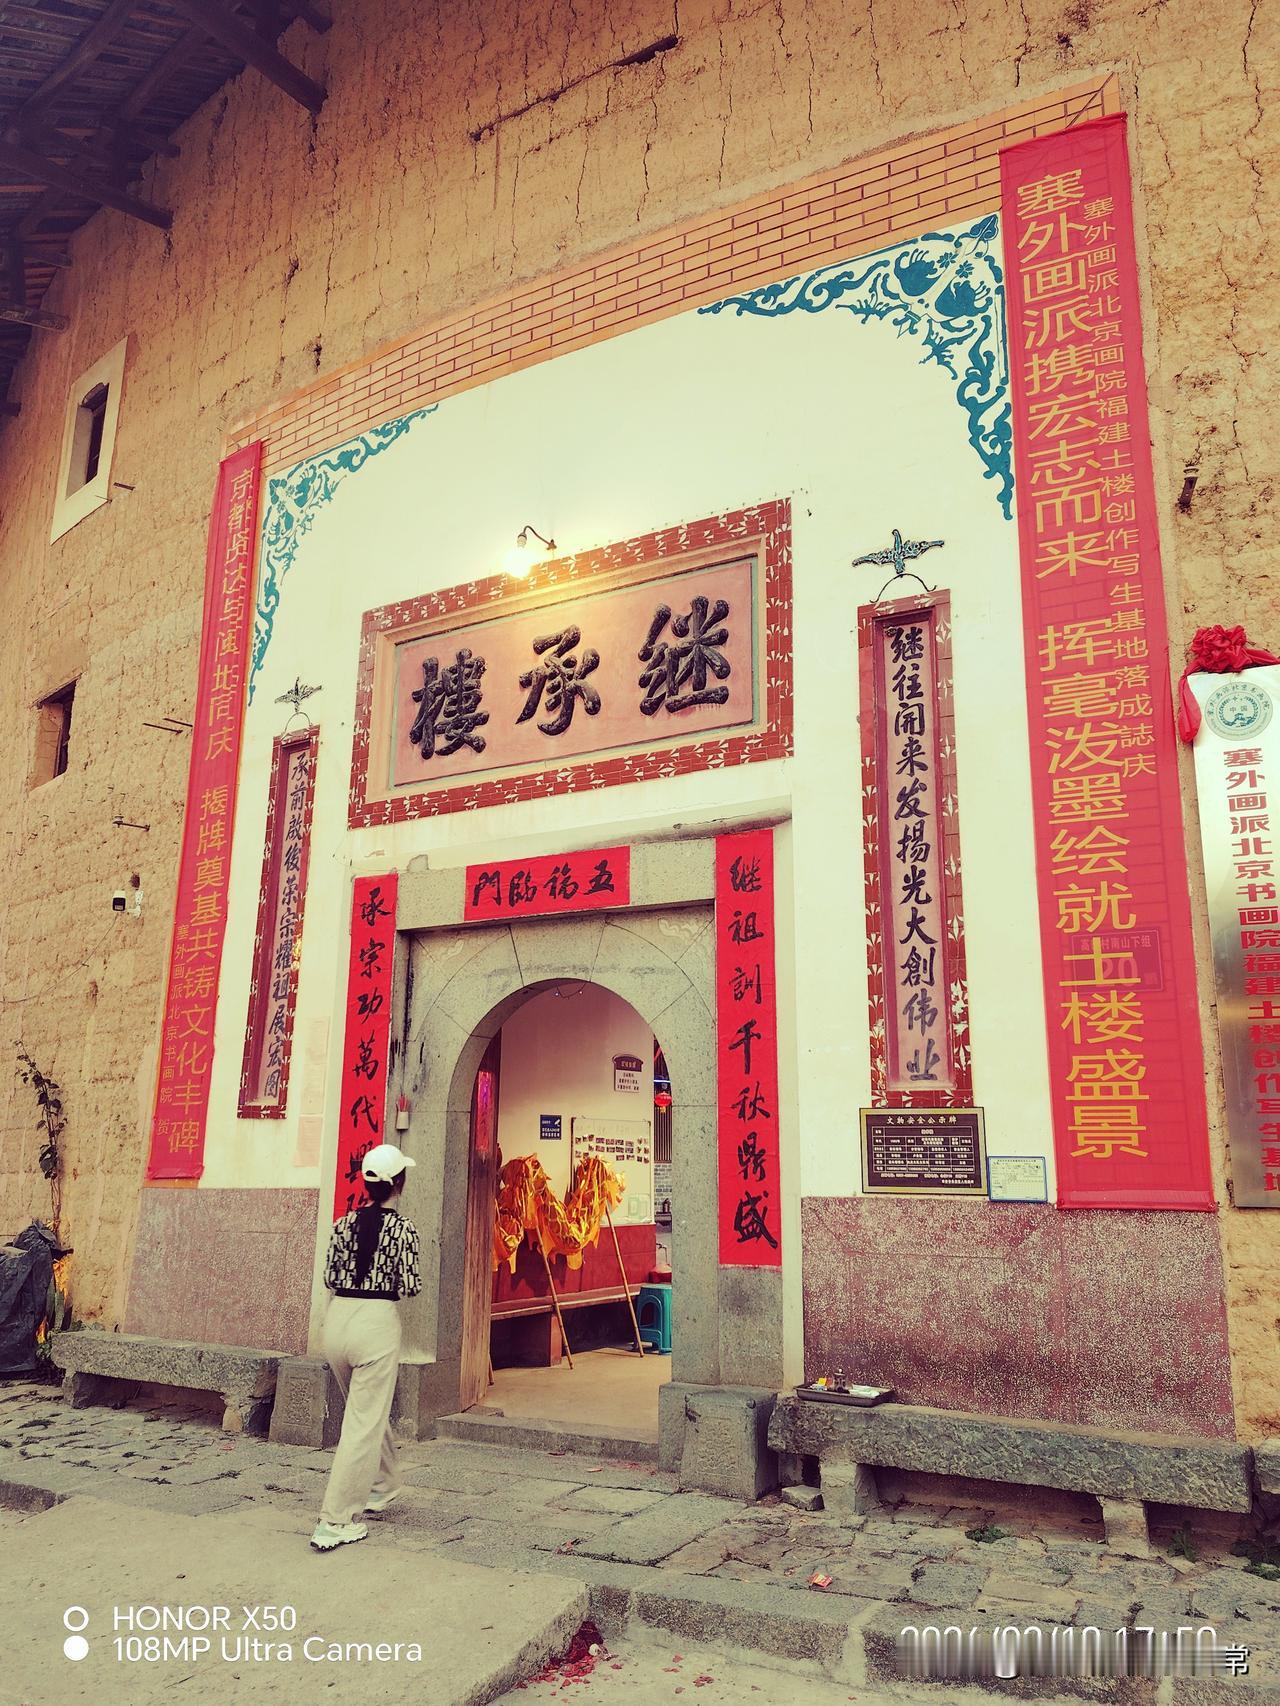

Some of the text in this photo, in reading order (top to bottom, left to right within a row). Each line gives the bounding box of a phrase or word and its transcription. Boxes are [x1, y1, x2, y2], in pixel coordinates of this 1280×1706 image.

[1016, 168, 1150, 1159] 塞外画派携宏志而来 挥毫泼墨绘就土楼盛景
[160, 924, 190, 1104] 塞外画派北京书画院
[167, 784, 229, 1156] 揭牌奠基共铸文化丰碑
